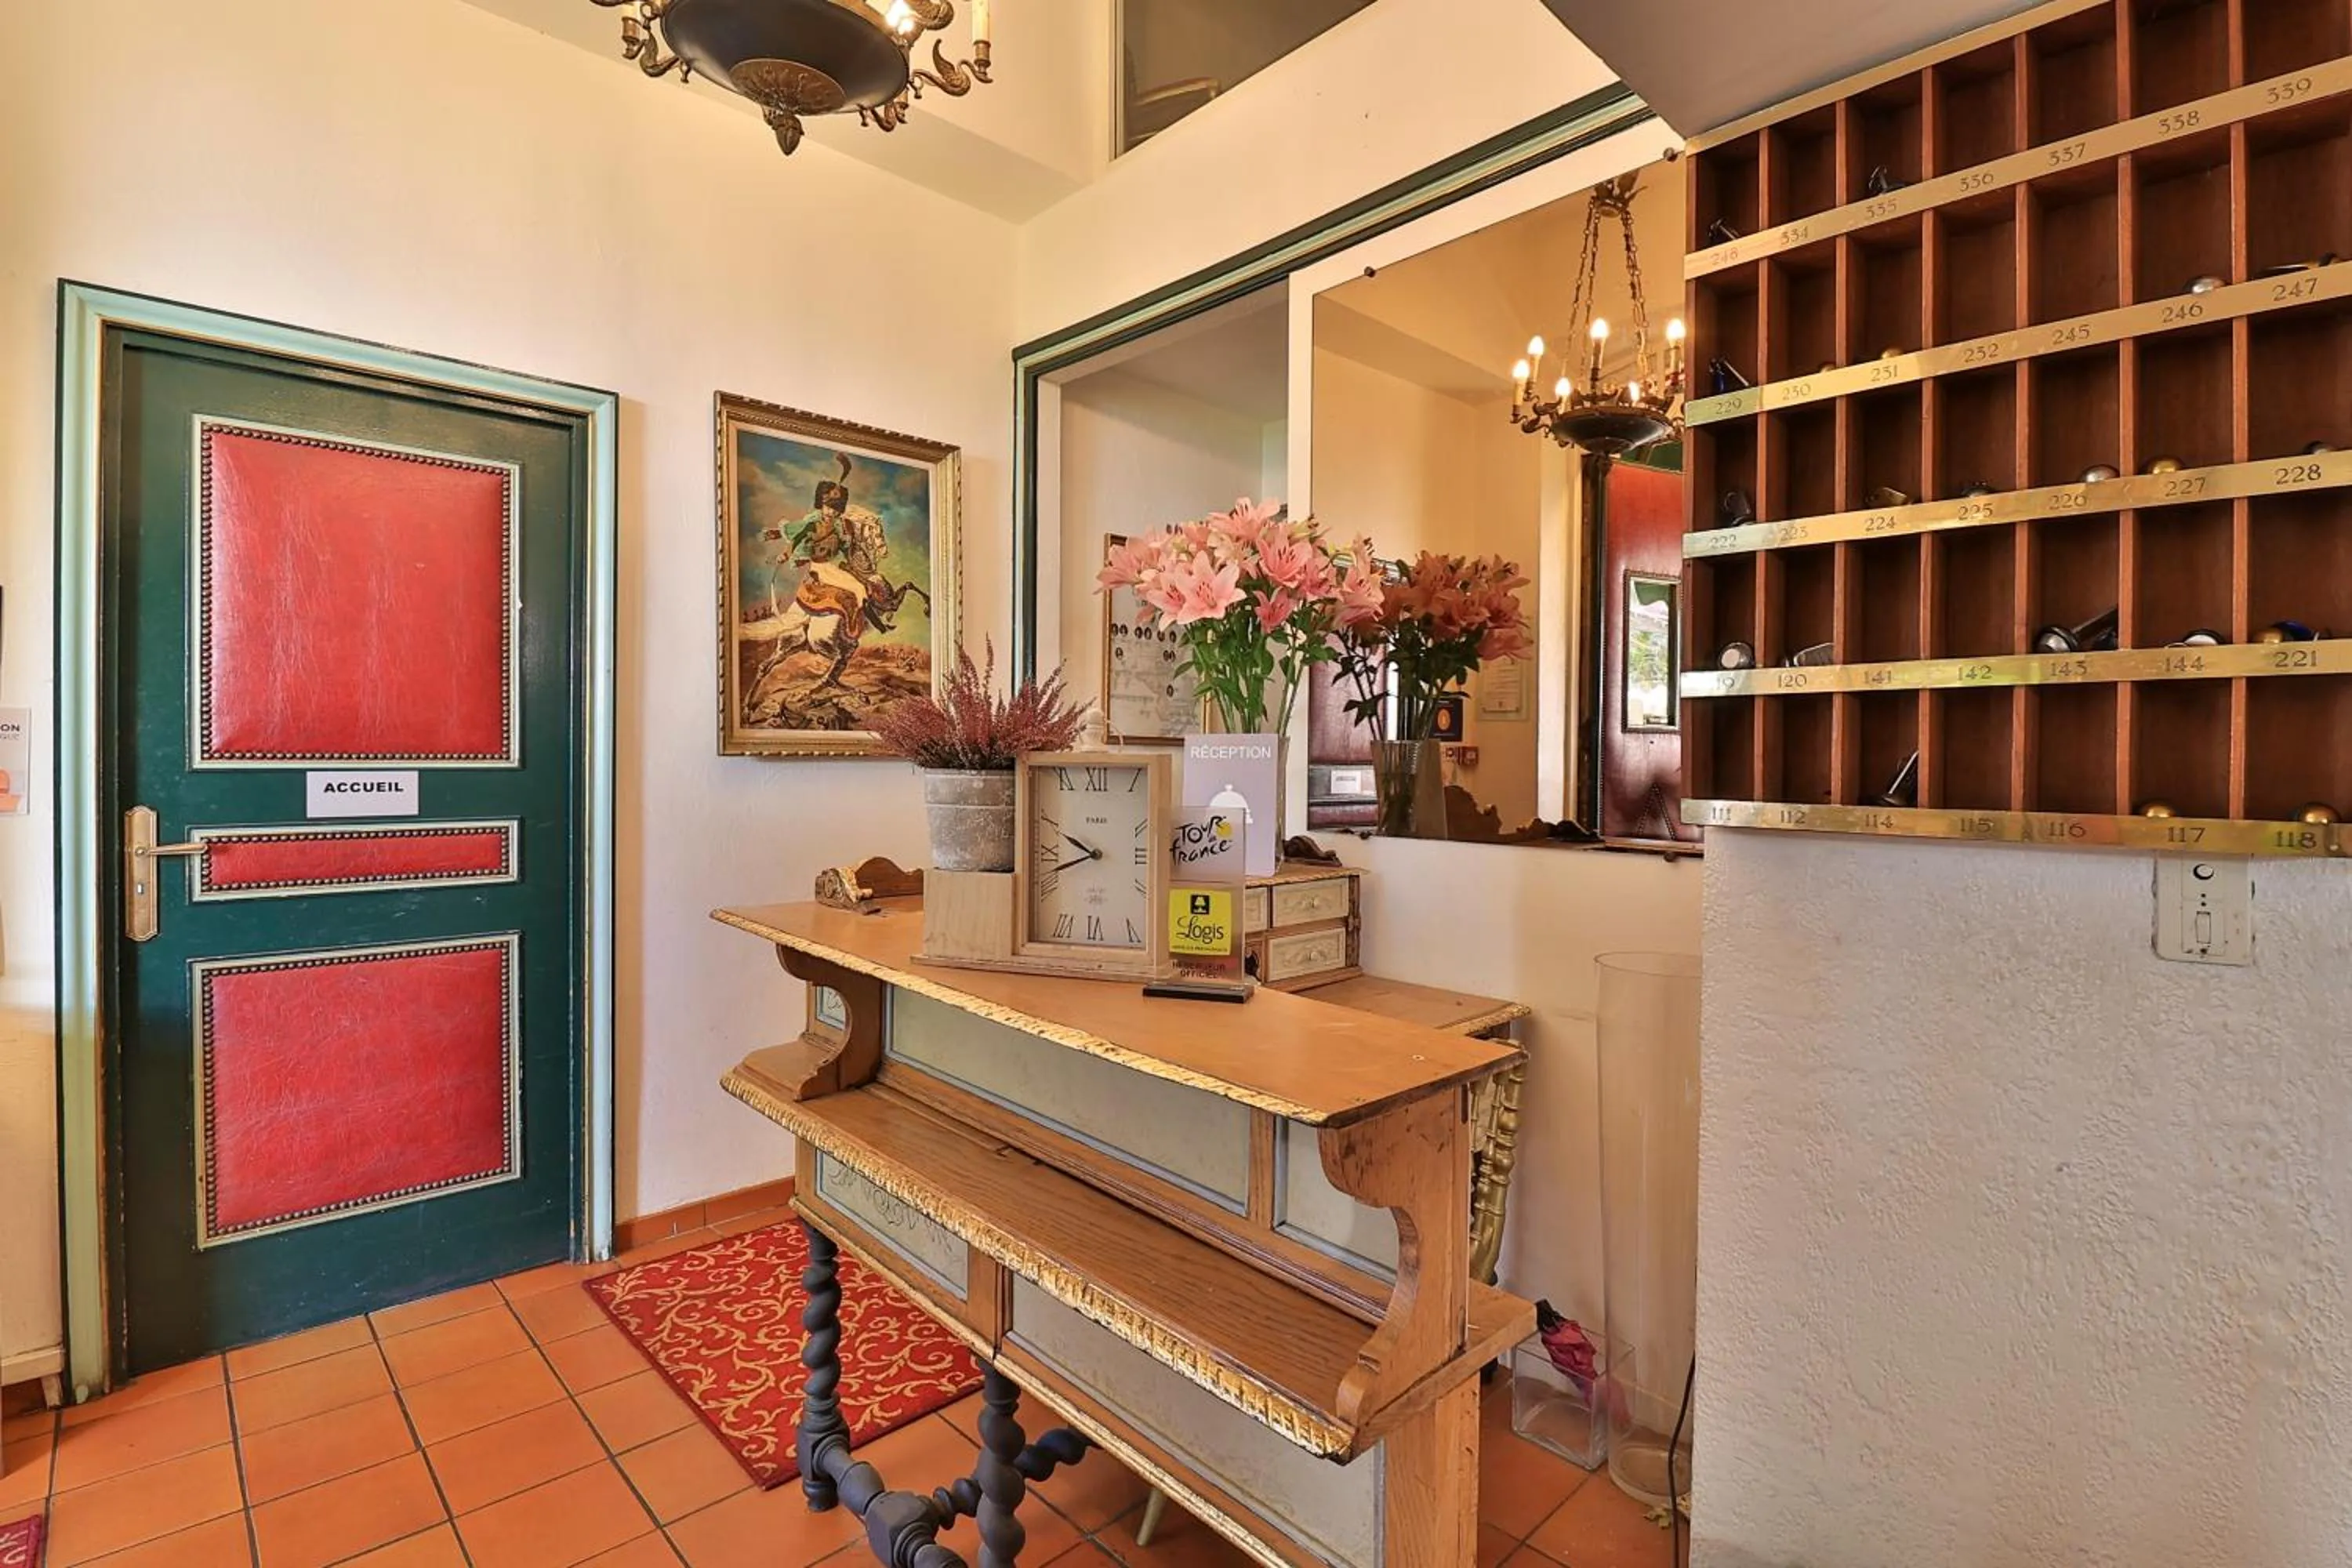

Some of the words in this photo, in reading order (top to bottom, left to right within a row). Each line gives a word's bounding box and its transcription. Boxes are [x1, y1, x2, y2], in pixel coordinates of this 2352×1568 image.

[1864, 198, 1898, 219] 335
[2048, 142, 2087, 167] 337
[2157, 111, 2201, 136] 338
[2267, 77, 2314, 104] 339
[1715, 397, 1743, 416] 229
[1781, 383, 1812, 401] 230
[1871, 365, 1899, 383] 231
[1963, 343, 2000, 364] 232
[2052, 324, 2091, 345] 245
[2161, 302, 2204, 324] 246
[2273, 278, 2319, 302] 247
[1710, 534, 1737, 550] 222
[1864, 515, 1897, 532] 224
[1958, 502, 1994, 521] 225
[2165, 476, 2207, 497] 227
[2274, 463, 2322, 485] 228
[1777, 673, 1808, 688] 120
[1864, 670, 1893, 684] 141
[1958, 664, 1993, 681] 142
[2050, 659, 2088, 677] 143
[2164, 655, 2205, 672] 144
[2274, 650, 2318, 668] 221
[1191, 743, 1272, 759] RÉCEPTION
[324, 782, 405, 793] ACCUEIL
[1711, 807, 1732, 821] 111
[1780, 811, 1806, 824] 112
[1864, 814, 1895, 829] 114
[1960, 818, 1994, 833] 115
[2048, 822, 2087, 838] 116
[2168, 827, 2206, 843] 117
[2276, 831, 2317, 848] 118
[1176, 916, 1225, 945] Logis
